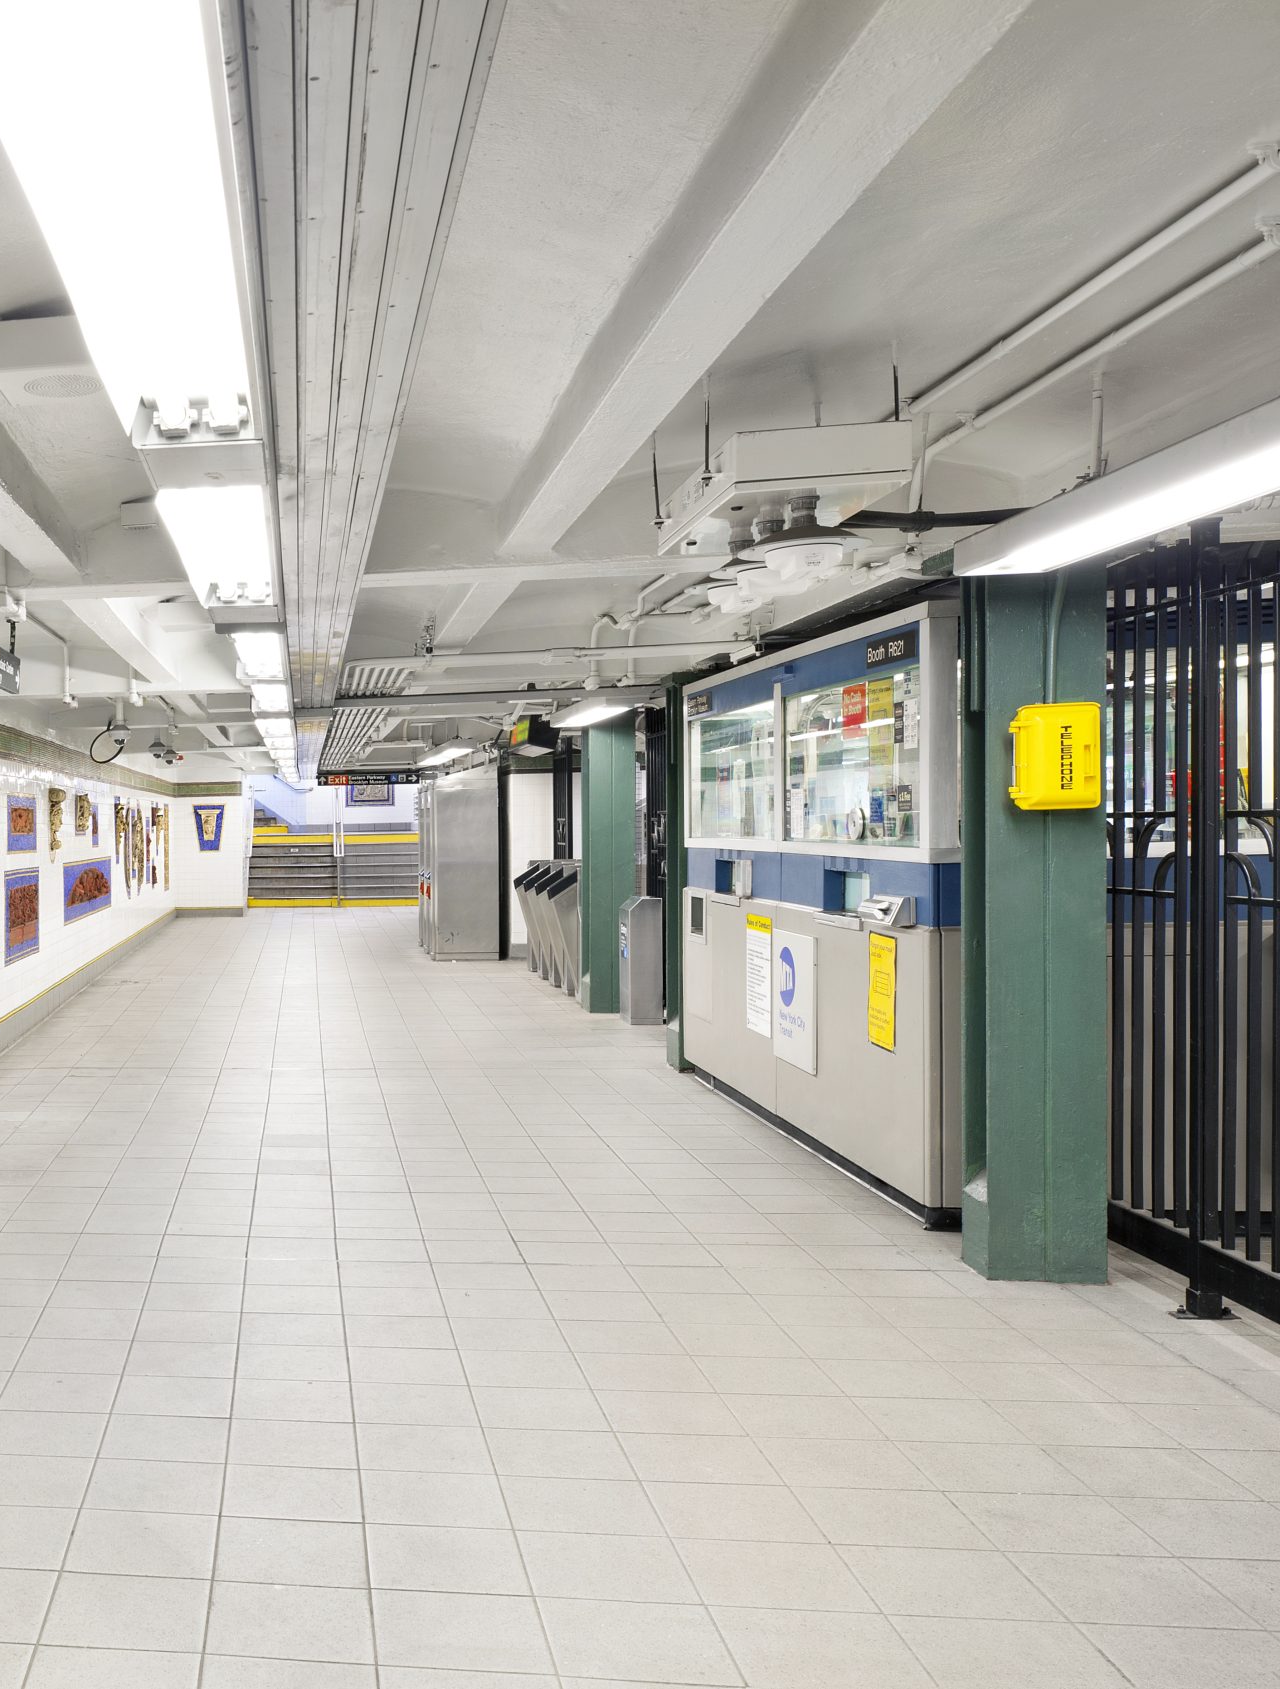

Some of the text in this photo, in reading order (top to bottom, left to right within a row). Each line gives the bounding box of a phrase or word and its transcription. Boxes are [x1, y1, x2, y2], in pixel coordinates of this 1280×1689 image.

[867, 640, 904, 663] Booth R621
[1061, 725, 1073, 790] TELEPHONE
[328, 776, 347, 784] Exit
[779, 1023, 793, 1039] Transit
[788, 1011, 797, 1025] York
[797, 1014, 806, 1032] City
